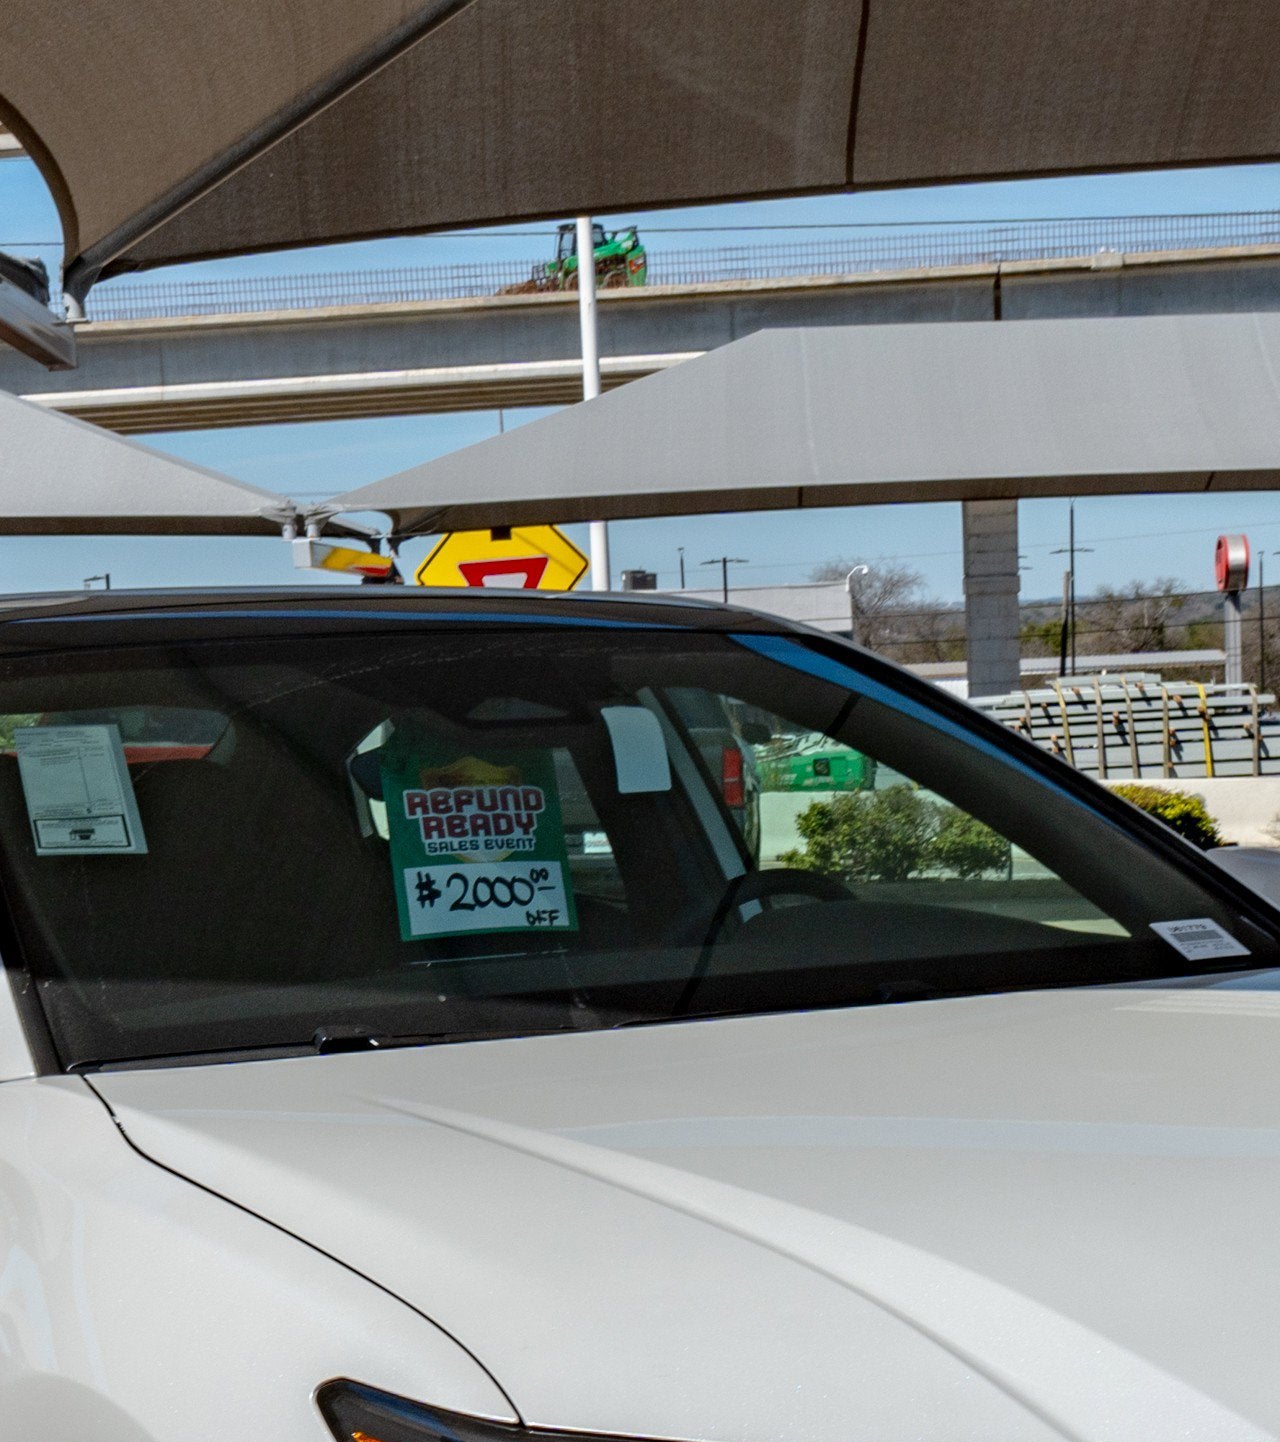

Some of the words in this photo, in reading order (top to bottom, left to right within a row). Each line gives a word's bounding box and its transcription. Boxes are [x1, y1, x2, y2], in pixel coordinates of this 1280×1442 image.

[404, 788, 544, 817] REFUND
[421, 812, 536, 840] READY
[427, 838, 480, 853] SALES
[484, 837, 535, 852] EVENT
